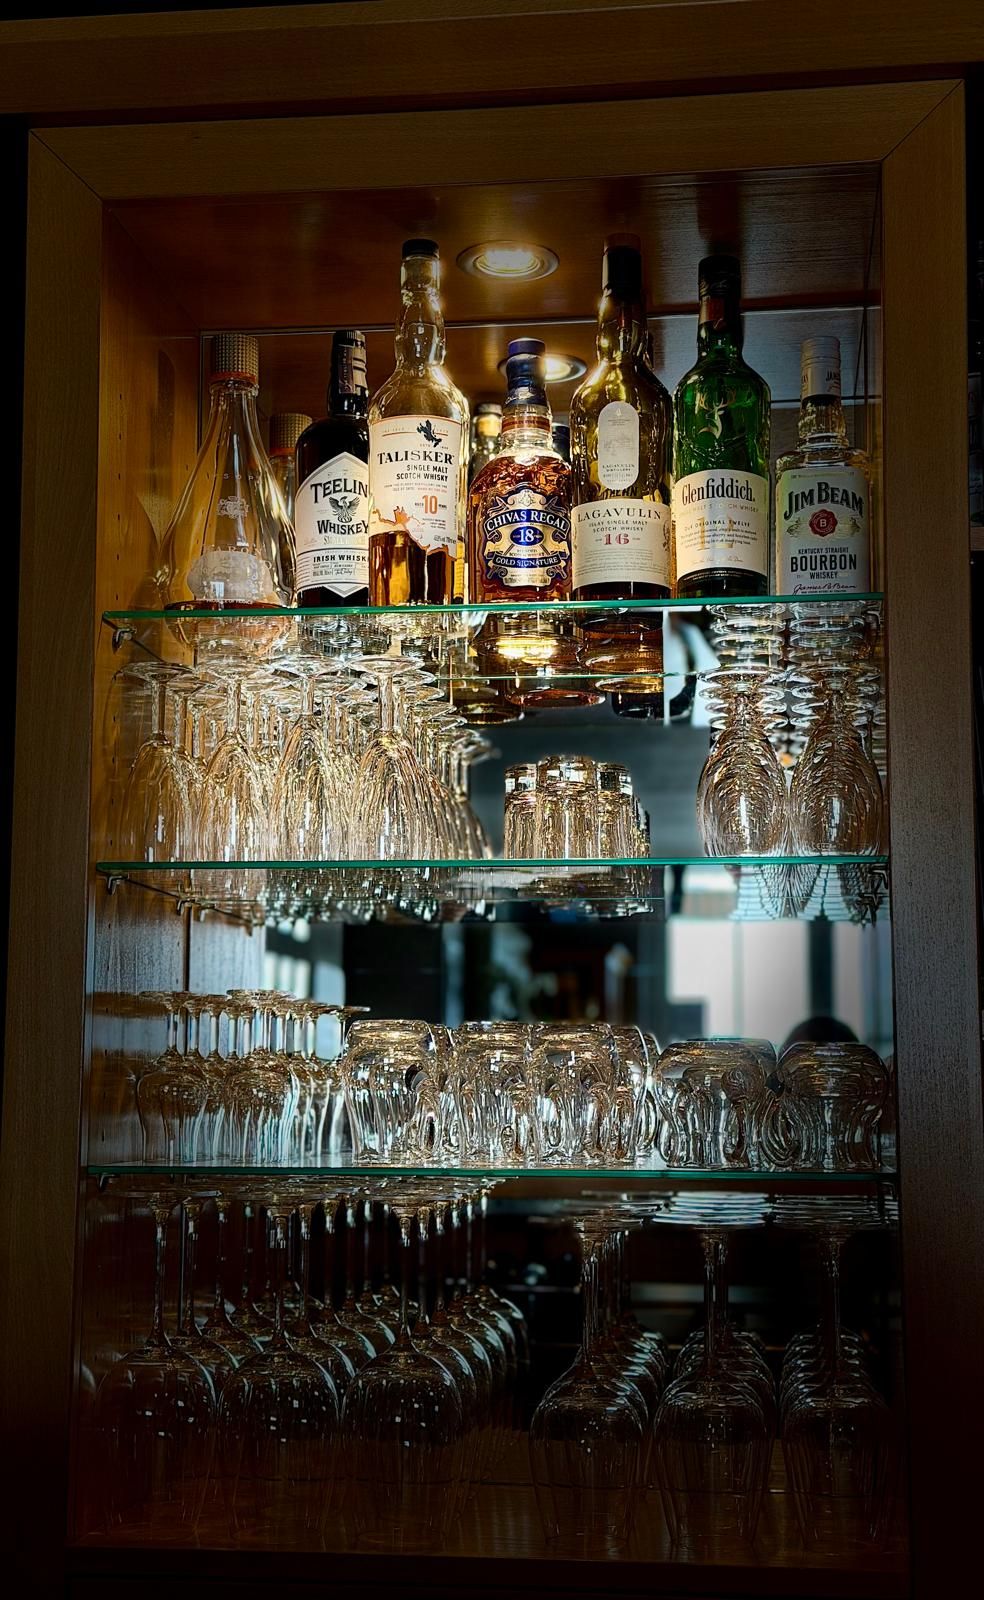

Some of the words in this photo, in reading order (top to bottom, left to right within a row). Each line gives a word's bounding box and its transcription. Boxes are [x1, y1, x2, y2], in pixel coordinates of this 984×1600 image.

[377, 449, 454, 465] TALISKER
[406, 464, 431, 472] SINGLE
[432, 465, 449, 474] MALT
[396, 472, 421, 480] SCOTCH
[423, 472, 449, 482] WHISKY
[310, 478, 368, 504] TEELIN
[682, 478, 754, 506] Glenfiddich
[422, 494, 438, 515] 10
[784, 488, 815, 521] JIM
[817, 481, 864, 518] BEAM
[486, 510, 527, 531] CHIVAS
[530, 510, 567, 532] REGAL
[577, 507, 661, 523] LAGAVULIN
[317, 519, 369, 536] WHISKEY
[592, 526, 617, 534] SCOTCH
[695, 519, 726, 529] ORIGINAL
[729, 520, 750, 528] TWELVE
[820, 519, 827, 528] B
[519, 528, 534, 543] 18
[604, 533, 630, 546] 16
[825, 546, 849, 554] STRAIGHT
[313, 554, 336, 563] IRISH
[338, 554, 367, 563] WHISK
[495, 556, 516, 567] GOLD
[516, 556, 558, 568] SIGNATURE
[790, 553, 857, 573] BOURBON
[809, 571, 838, 580] WHISKEY
